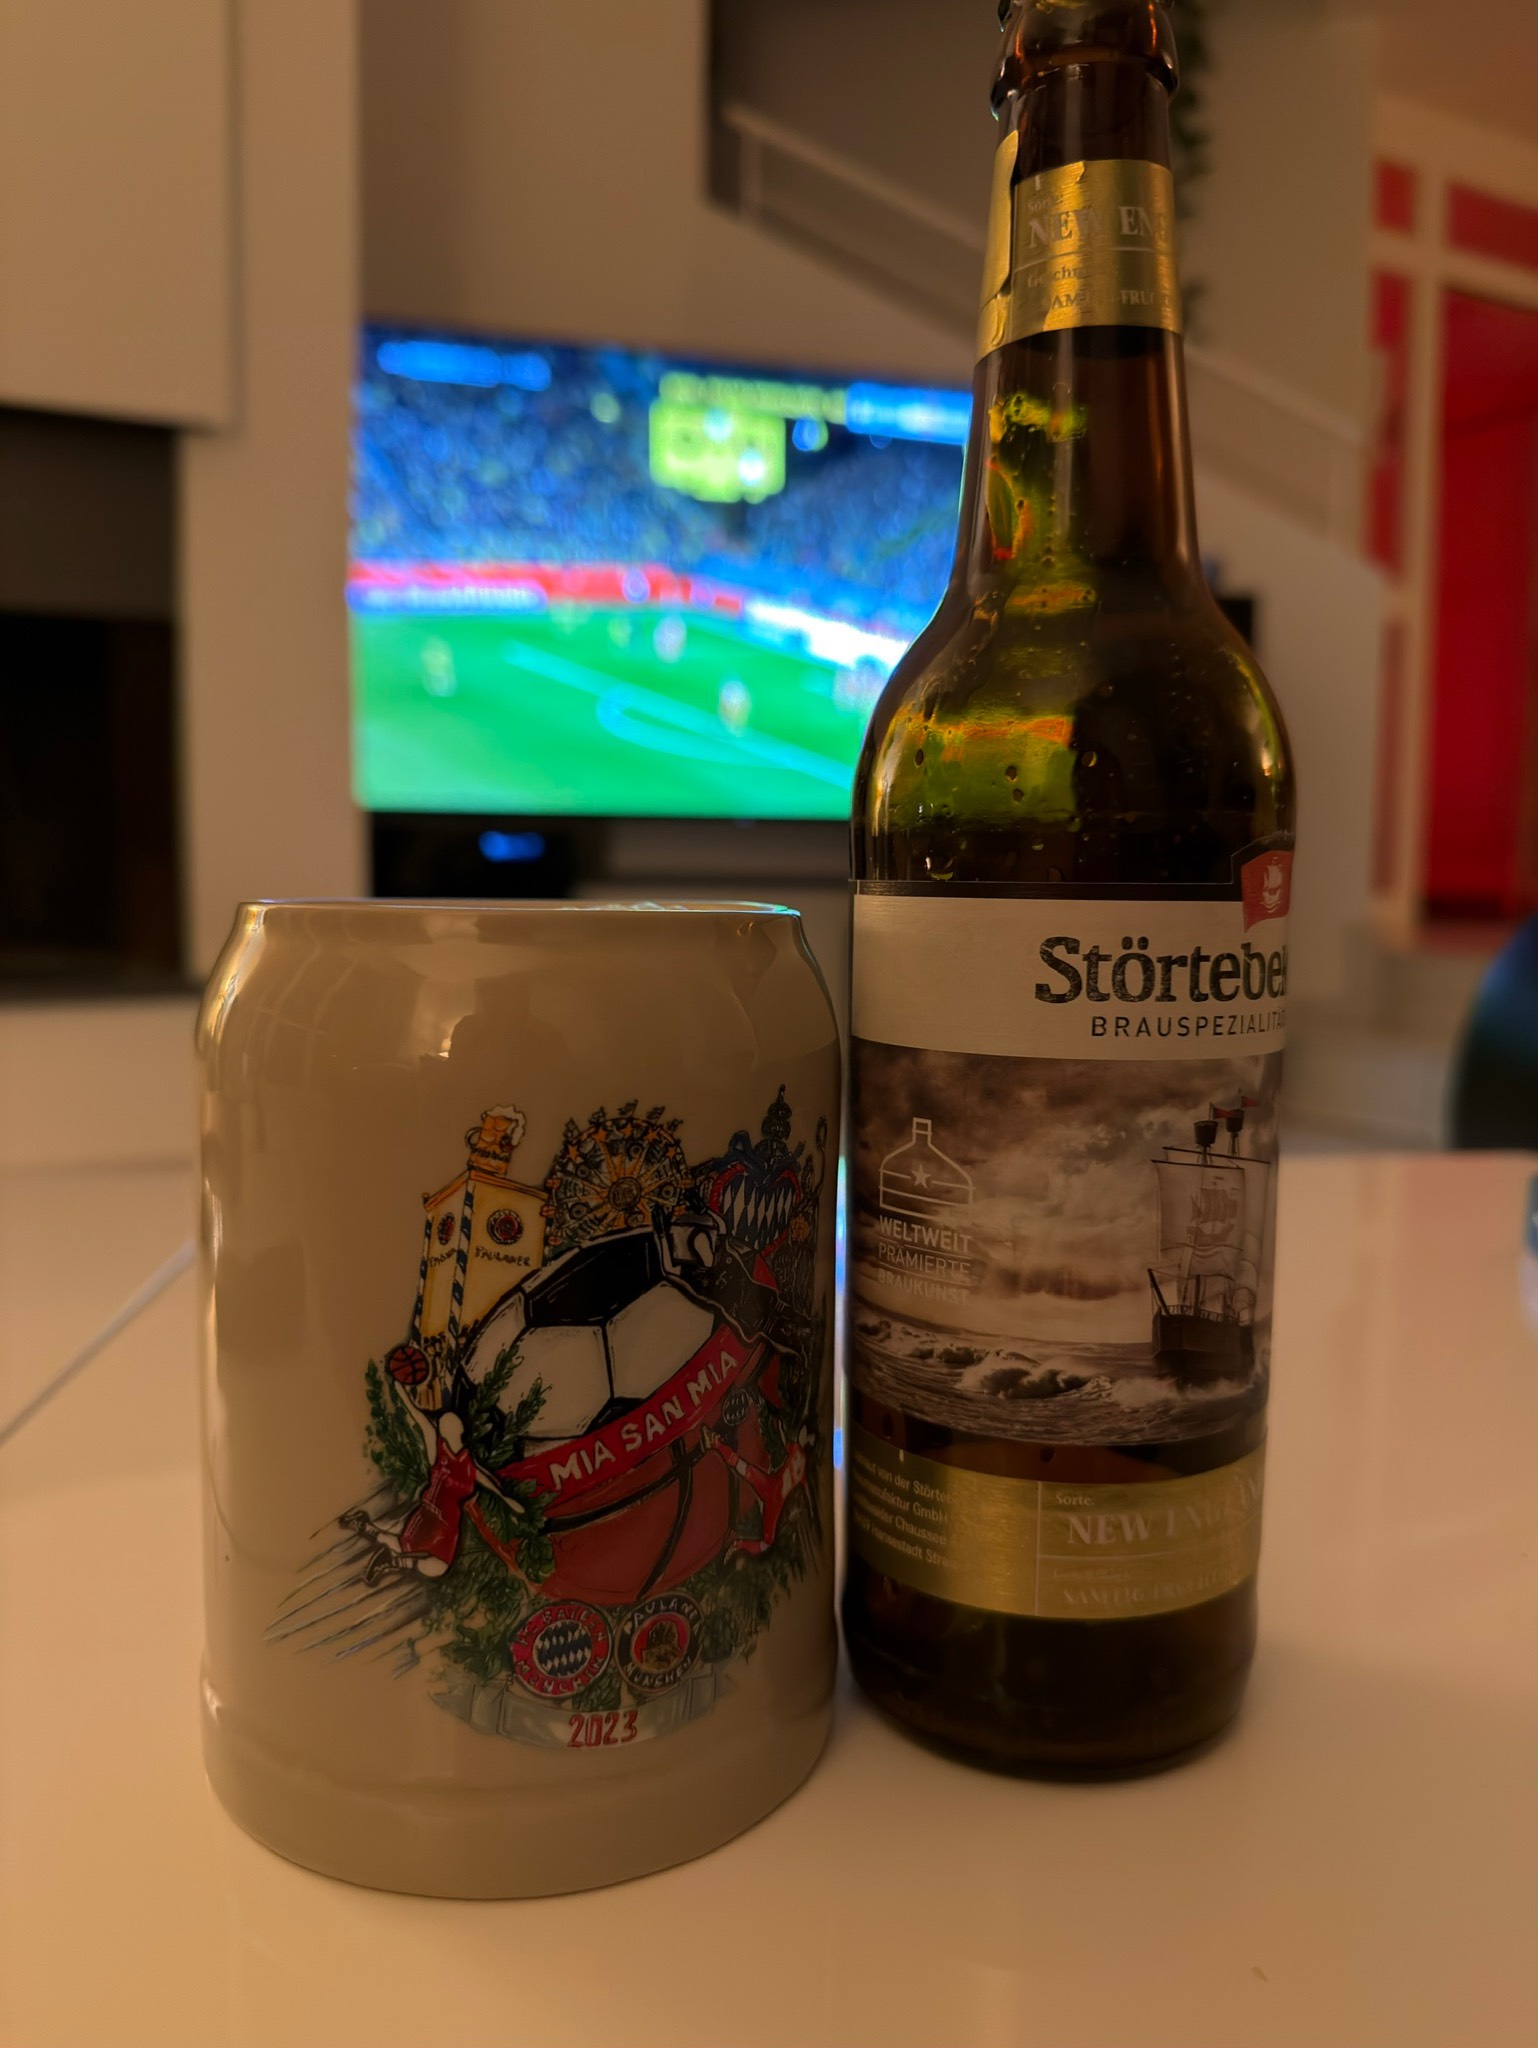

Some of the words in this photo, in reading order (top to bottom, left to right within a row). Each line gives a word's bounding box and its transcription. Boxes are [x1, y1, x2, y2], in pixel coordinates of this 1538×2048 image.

[1028, 207, 1106, 248] NEW
[880, 1214, 972, 1253] WELTWEIT
[879, 1242, 971, 1277] PRÄMIERTE
[879, 1269, 970, 1304] BRAUKUNST
[549, 1441, 617, 1491] MIA
[621, 1396, 685, 1452] SAN
[687, 1351, 738, 1408] MIA
[894, 1473, 911, 1490] der
[894, 1514, 947, 1545] Chaussee
[1067, 1511, 1151, 1545] NEW
[566, 1710, 639, 1748] 2023
